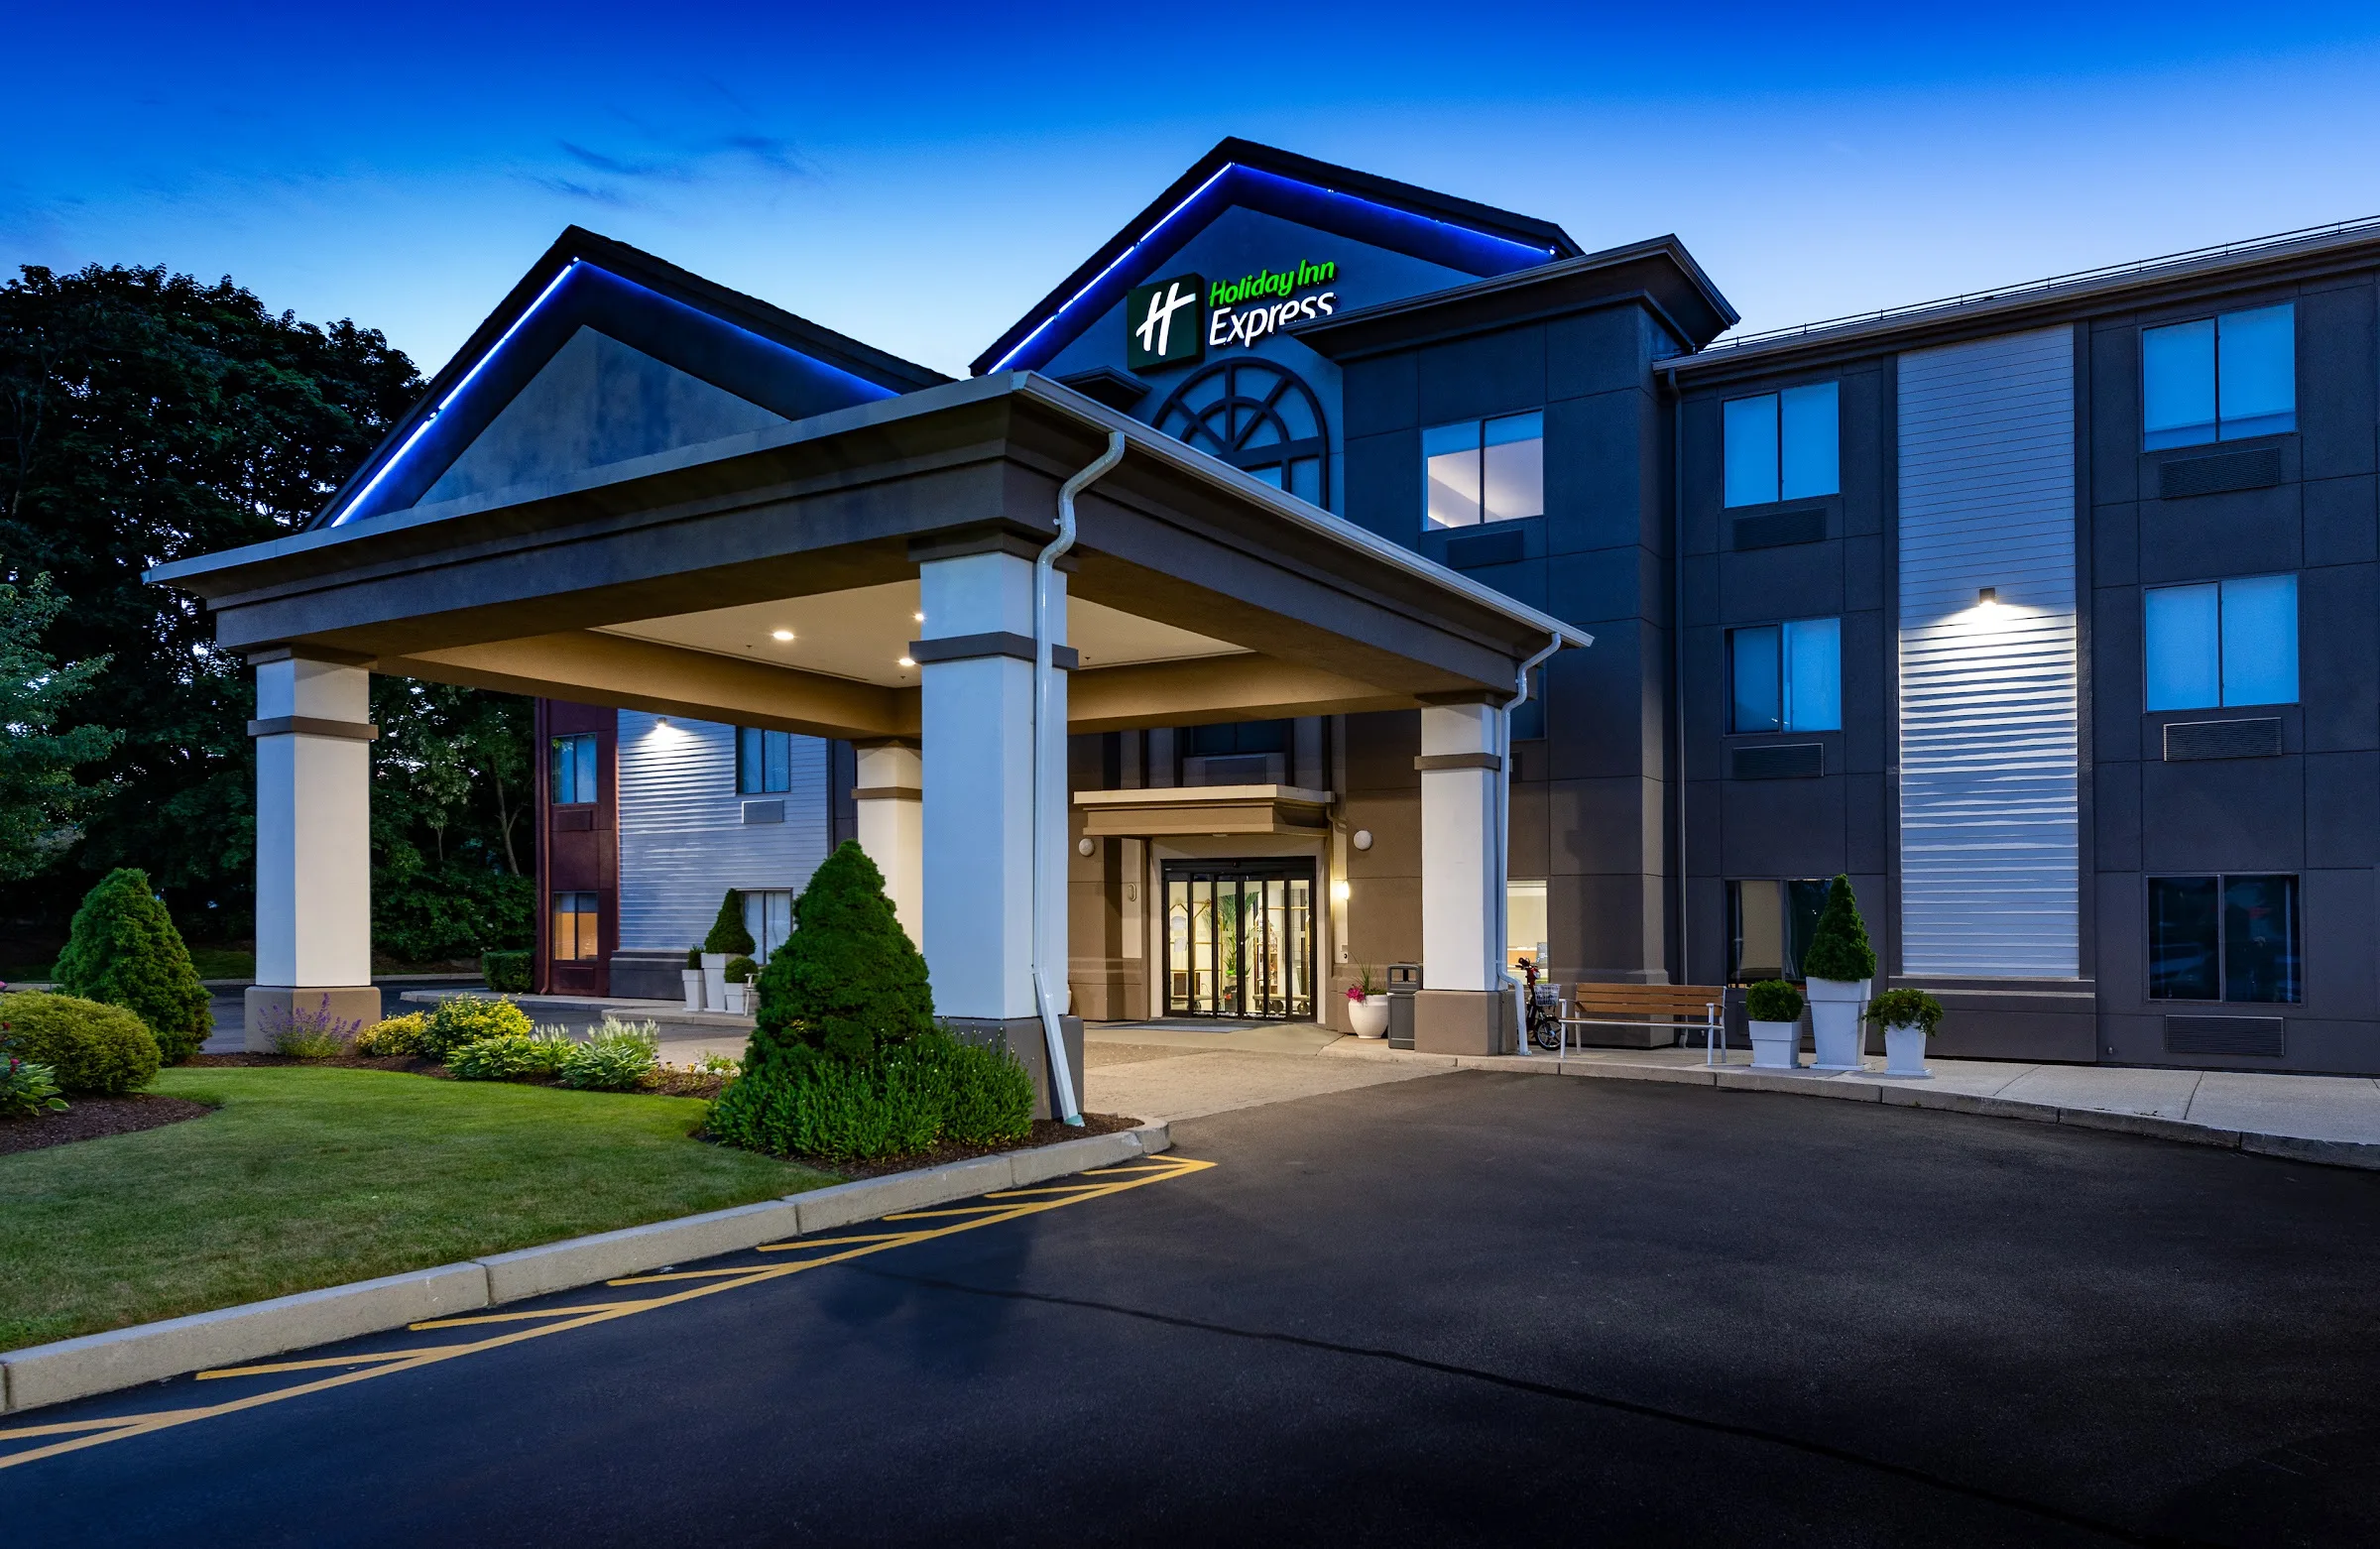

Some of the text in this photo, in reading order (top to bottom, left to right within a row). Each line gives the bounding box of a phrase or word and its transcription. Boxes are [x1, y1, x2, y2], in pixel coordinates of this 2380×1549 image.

[1209, 259, 1335, 306] Holiday Inn
[1209, 292, 1335, 347] Express
